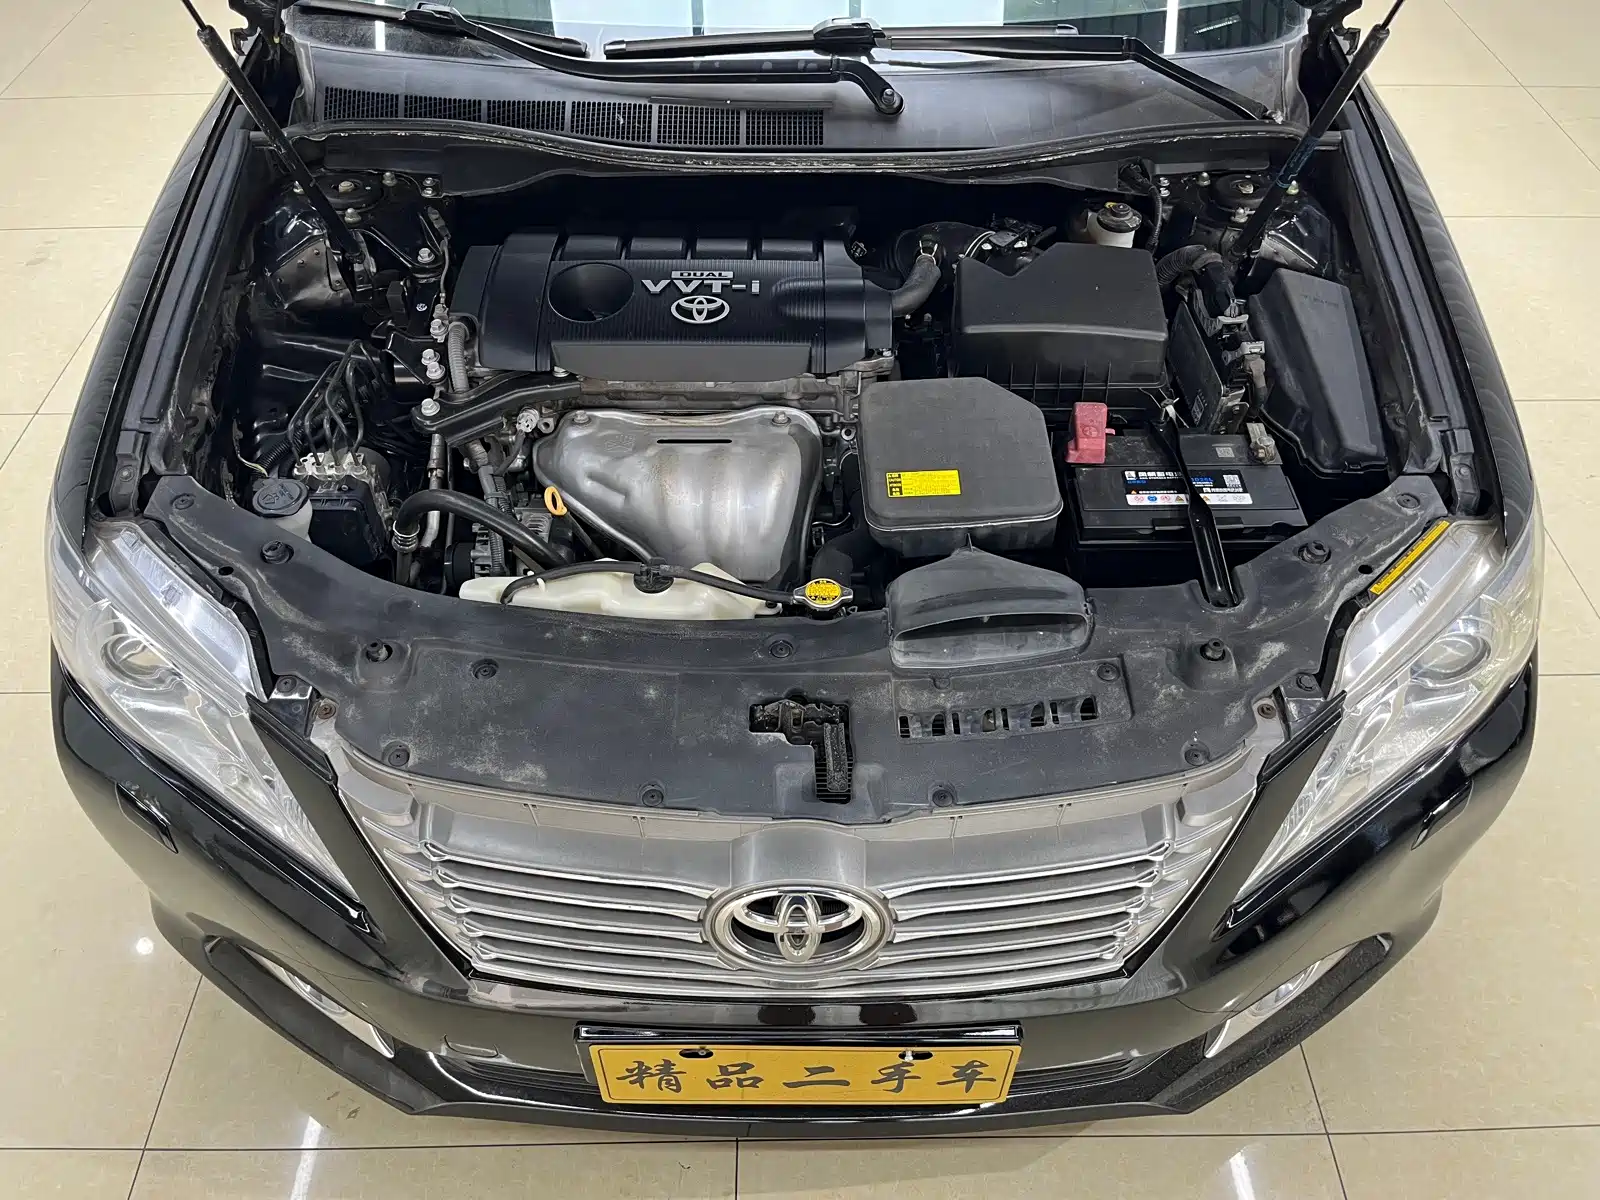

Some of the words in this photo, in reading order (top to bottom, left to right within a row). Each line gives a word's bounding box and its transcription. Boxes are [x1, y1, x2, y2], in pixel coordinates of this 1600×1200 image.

[641, 279, 760, 294] VVT-i
[616, 1058, 997, 1093] 精品二手车
